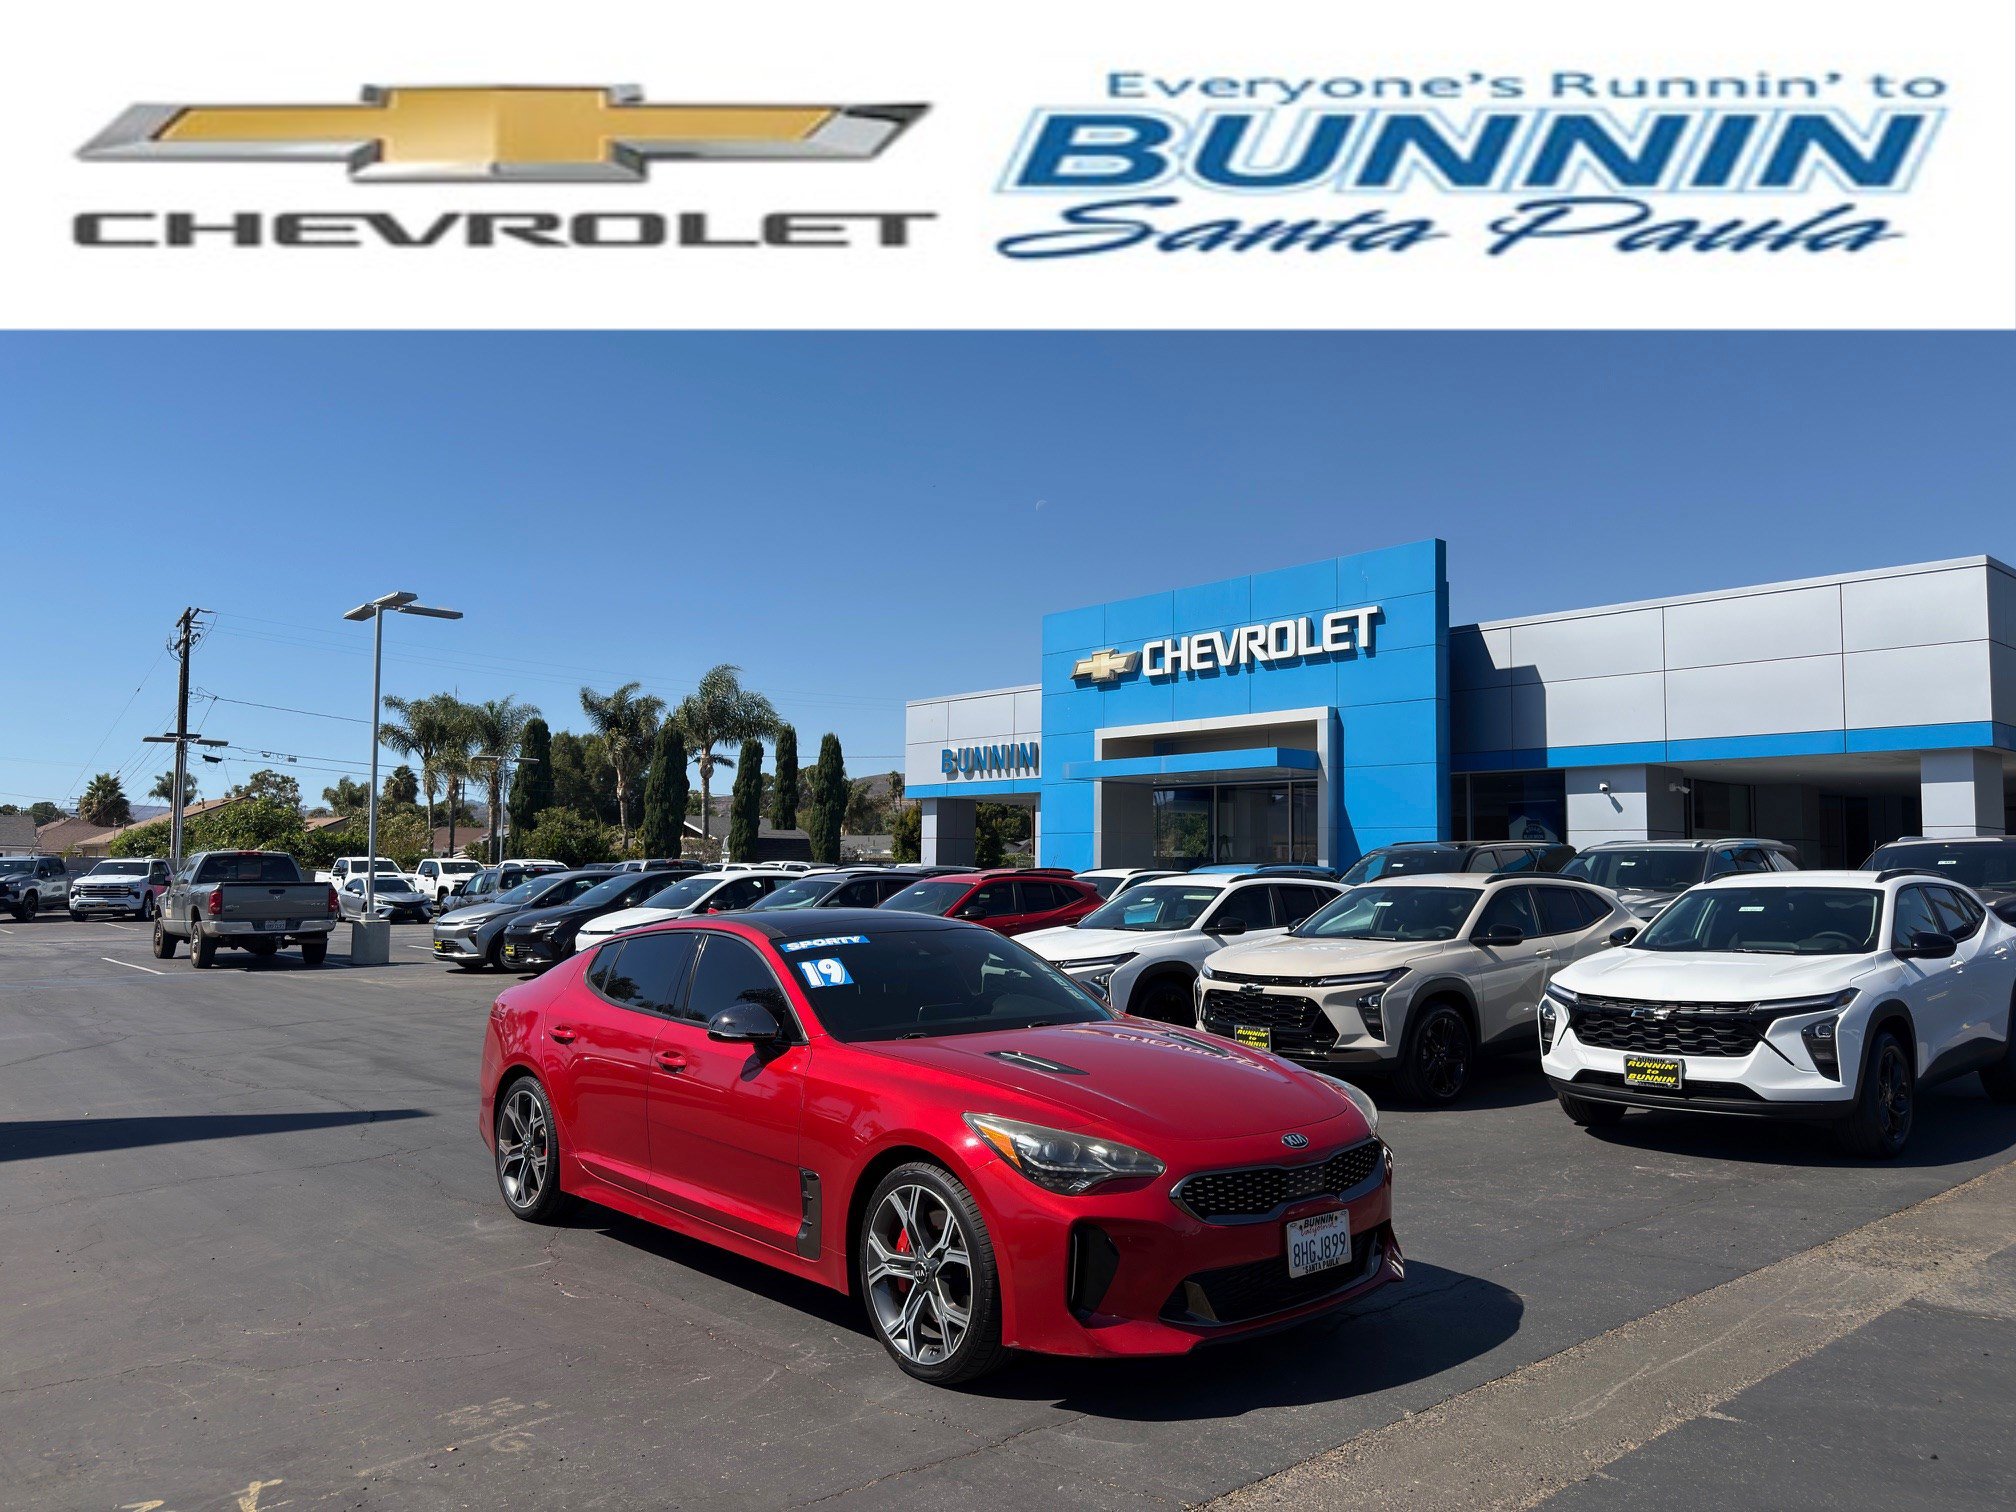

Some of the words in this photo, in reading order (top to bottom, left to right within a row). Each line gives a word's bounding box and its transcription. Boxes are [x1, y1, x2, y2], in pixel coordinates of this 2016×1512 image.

[1142, 605, 1382, 677] CHEVROLET
[941, 742, 1038, 774] BUNNIN
[786, 936, 861, 951] SPORTY
[801, 958, 846, 986] 19
[1627, 1060, 1678, 1071] RUNNIN'
[1627, 1073, 1676, 1083] BUNNIN
[1284, 1133, 1307, 1146] KIA
[1303, 1213, 1335, 1228] BUNNIN
[1293, 1231, 1346, 1268] 8HGJ899
